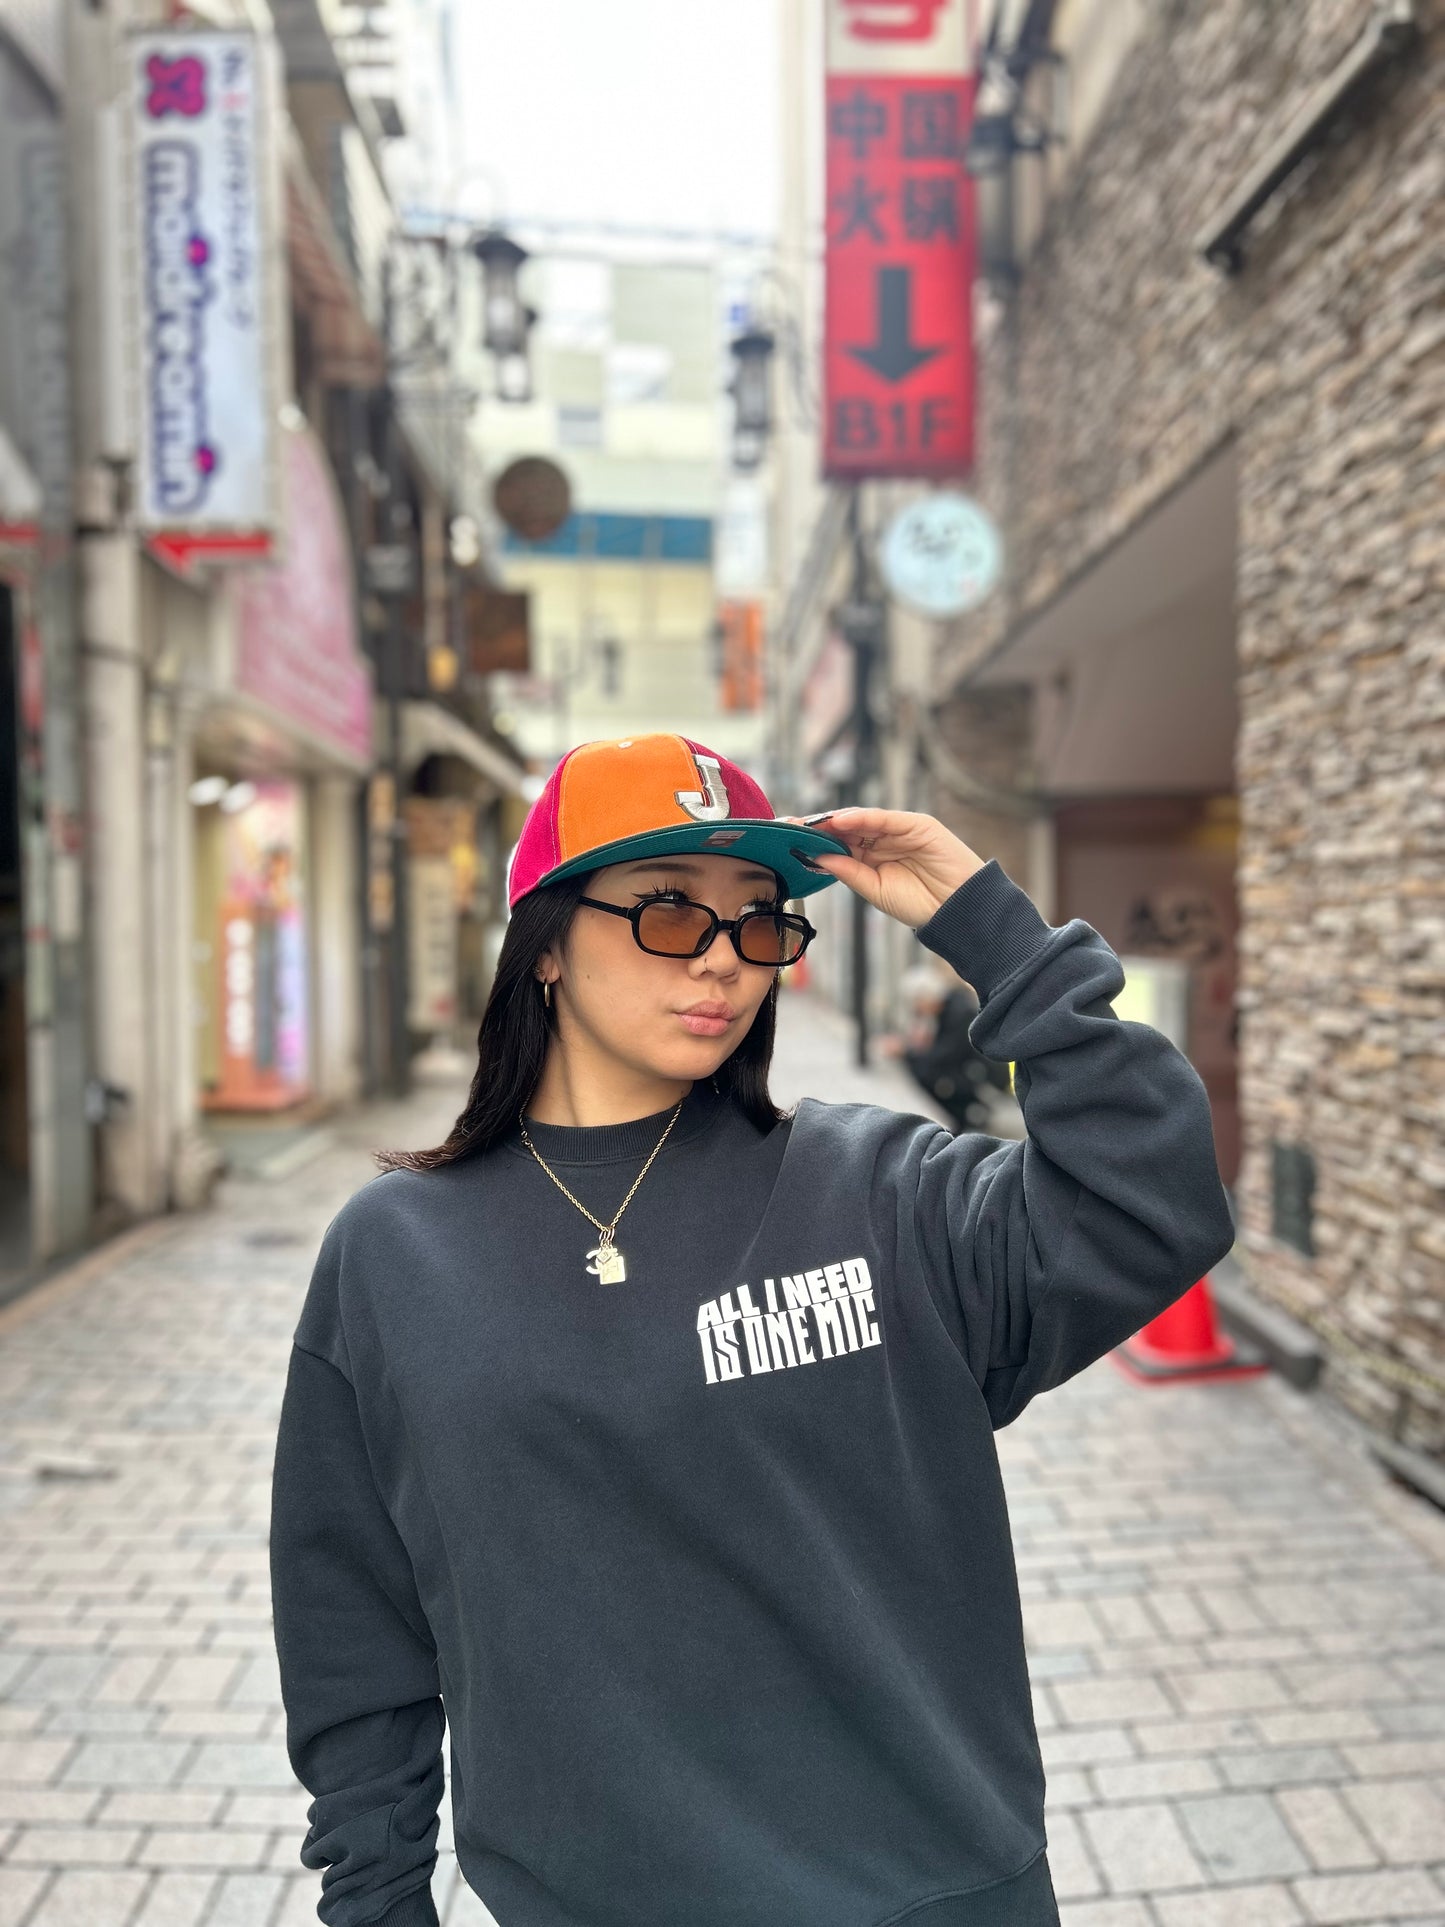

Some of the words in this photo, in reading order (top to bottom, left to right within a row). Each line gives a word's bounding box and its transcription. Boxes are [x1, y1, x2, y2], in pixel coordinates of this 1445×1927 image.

[830, 87, 958, 158] 中国
[835, 396, 954, 450] B1F
[675, 754, 730, 820] J
[697, 1284, 761, 1331] ALL
[764, 1278, 779, 1313] I
[781, 1257, 873, 1310] NEED
[697, 1319, 745, 1385] IS
[741, 1307, 818, 1375] ONE
[811, 1288, 882, 1360] MIC
